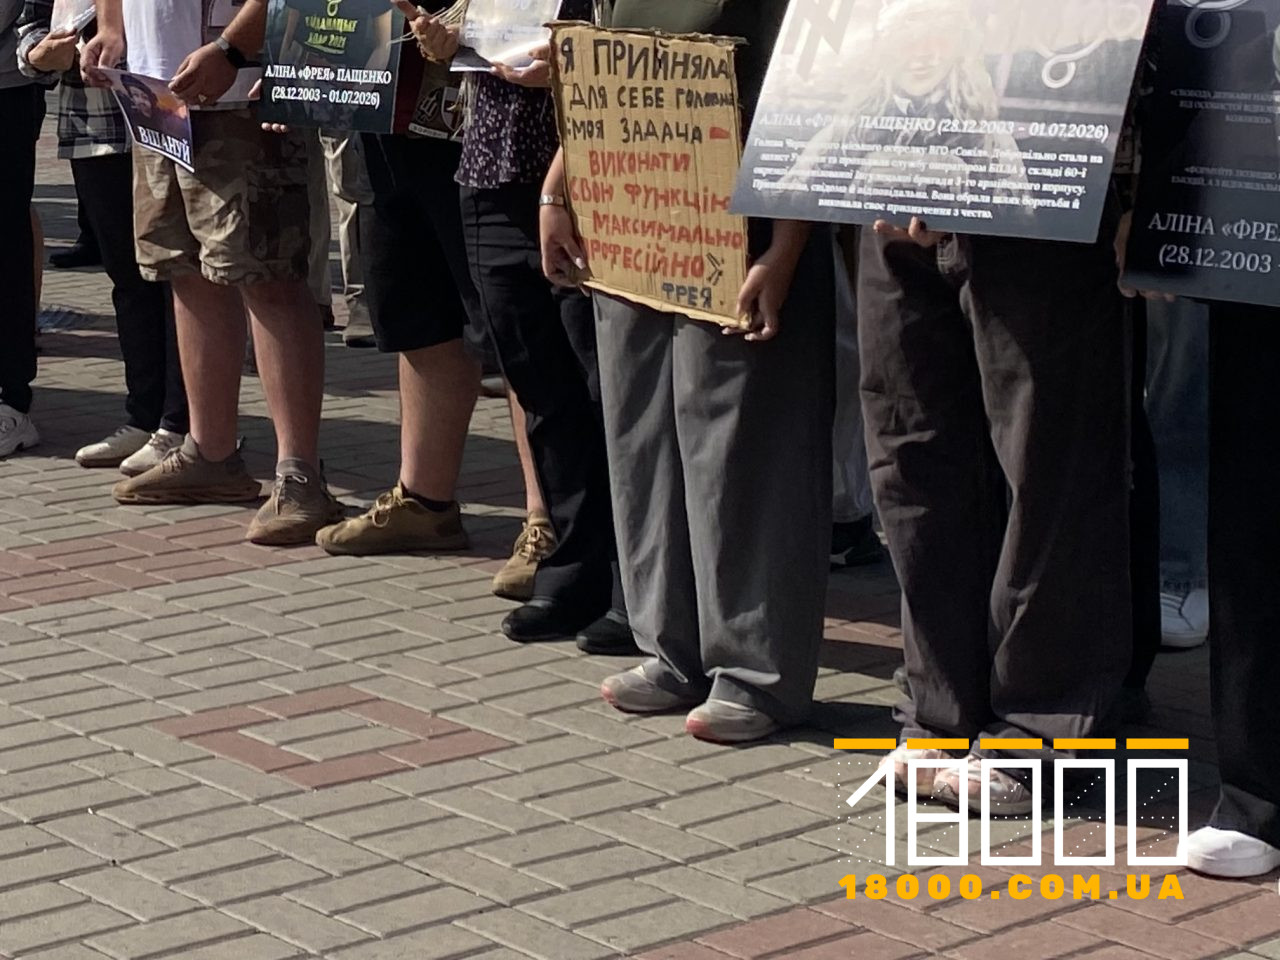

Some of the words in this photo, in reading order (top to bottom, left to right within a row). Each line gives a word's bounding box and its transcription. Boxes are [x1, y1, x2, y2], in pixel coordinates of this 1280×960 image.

[593, 38, 730, 81] ПРИЙНЯЛА
[265, 65, 296, 79] АЛІНА
[298, 65, 335, 81] «ФРЕЯ»
[336, 68, 392, 84] ПАЩЕНКО
[271, 86, 321, 102] (28.12.2003
[328, 90, 380, 109] 01.07.2026)
[570, 82, 608, 111] ДЛЯ
[617, 86, 664, 109] СЕБЕ
[621, 117, 703, 144] ЗАДАЧА
[858, 116, 936, 132] ПАЩЕНКО
[937, 119, 1015, 136] (28.12.2003
[1028, 122, 1110, 143] 01.07.2026)
[137, 125, 191, 164] ВШАНУЙ
[588, 150, 691, 177] ВИКОНАТИ
[593, 210, 743, 250] МАКСИМАЛЬНО
[1148, 212, 1215, 235] АЛІНА
[1221, 218, 1280, 242] «ФРЕ
[1158, 243, 1272, 273] (28.12.2003
[661, 283, 712, 309] ФРЕЯ
